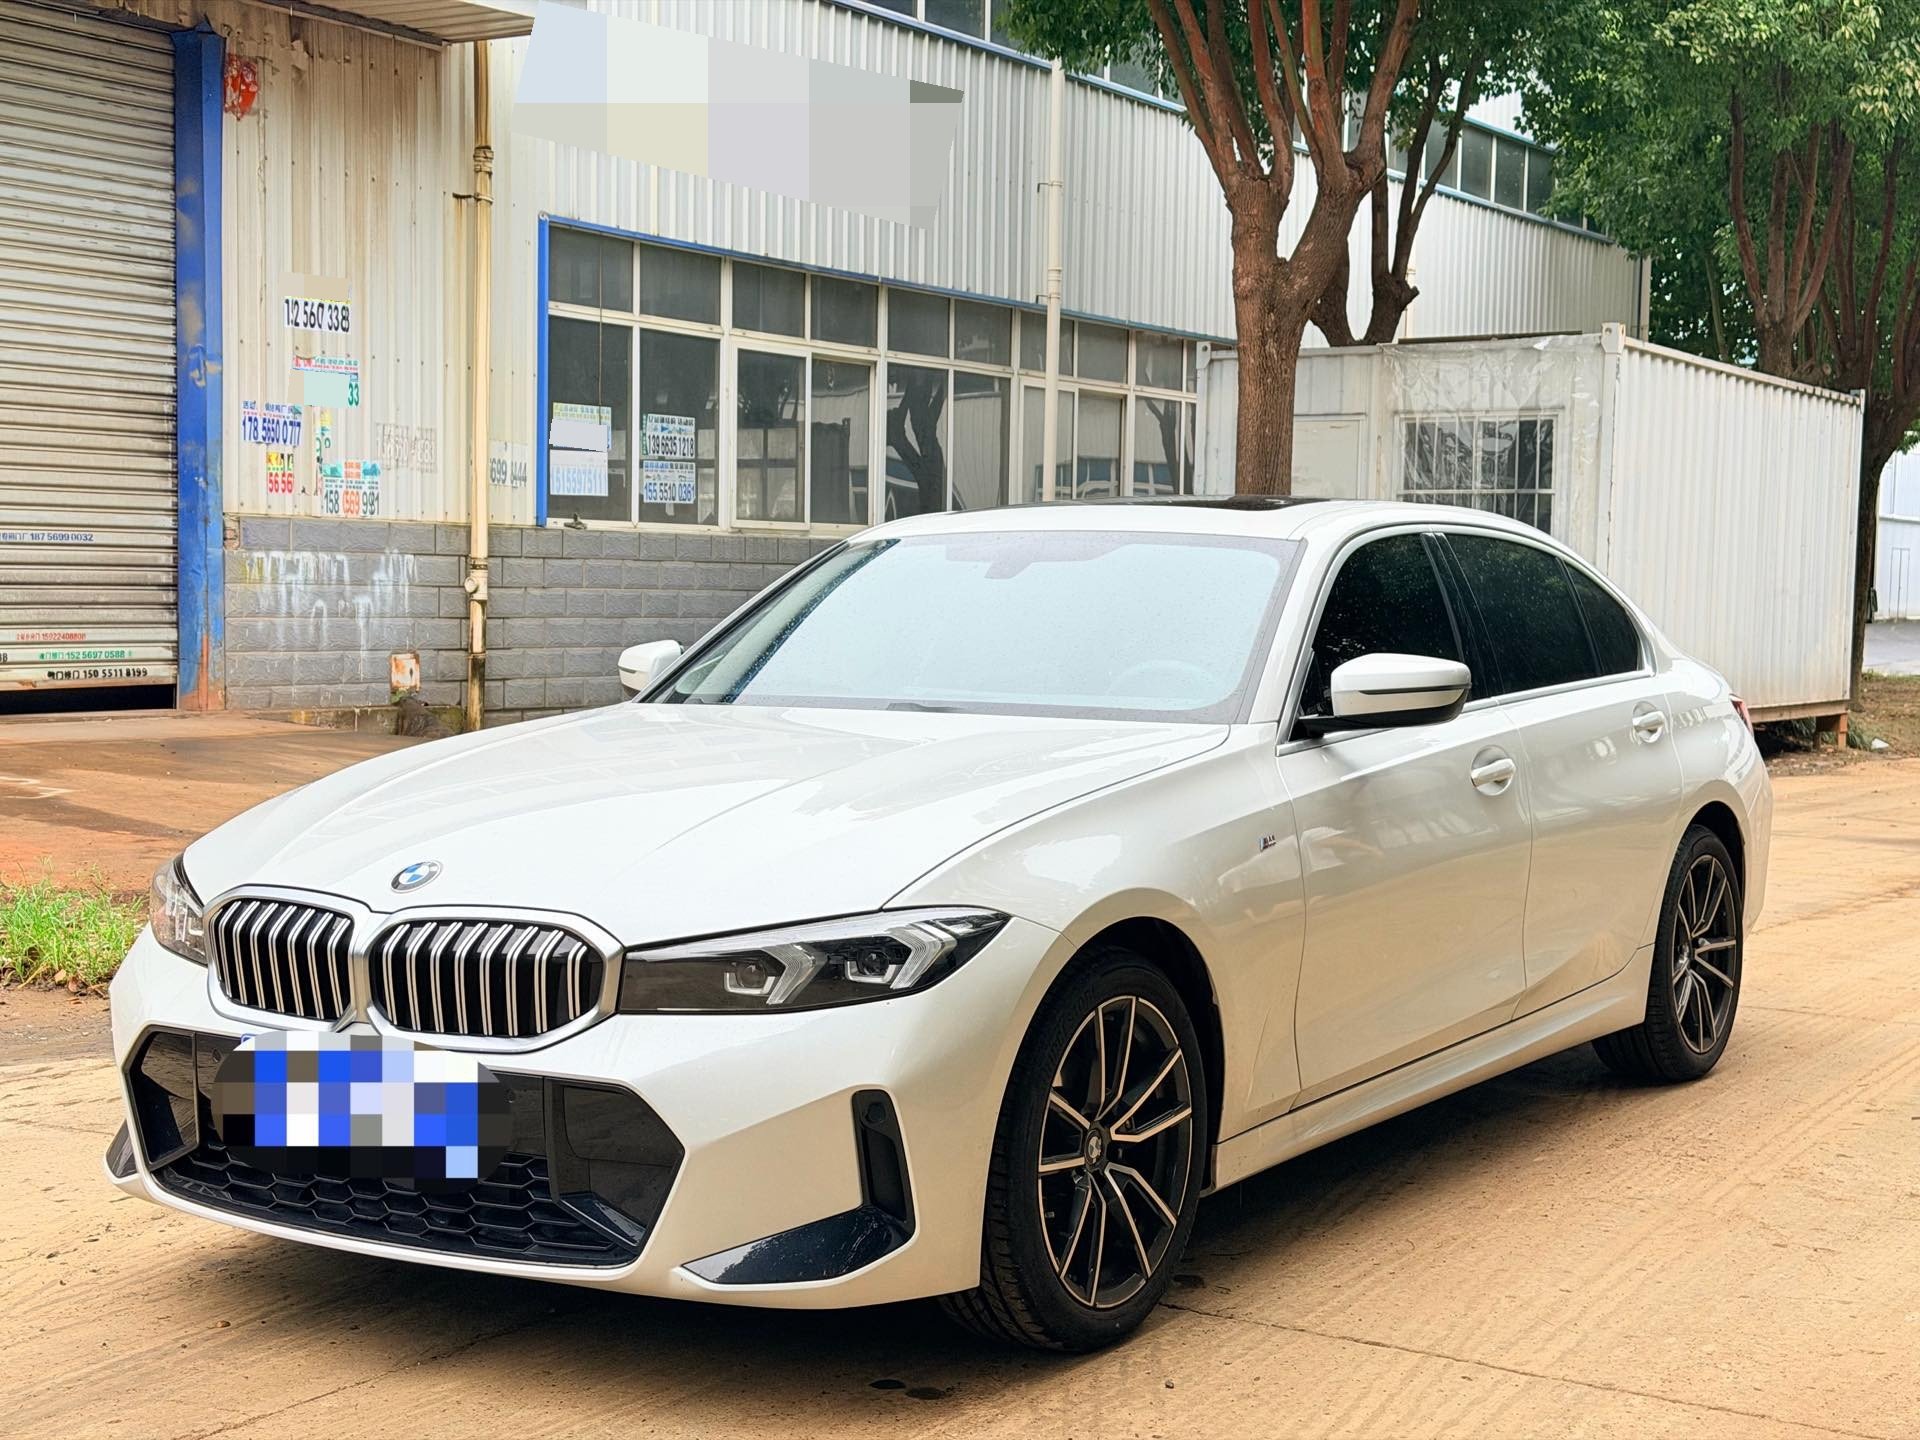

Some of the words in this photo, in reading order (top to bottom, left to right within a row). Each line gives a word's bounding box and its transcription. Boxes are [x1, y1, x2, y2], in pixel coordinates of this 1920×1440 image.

[242, 416, 259, 441] 178
[324, 489, 340, 514] 158
[67, 651, 80, 660] 152
[83, 669, 99, 679] 150
[102, 669, 123, 679] 5511
